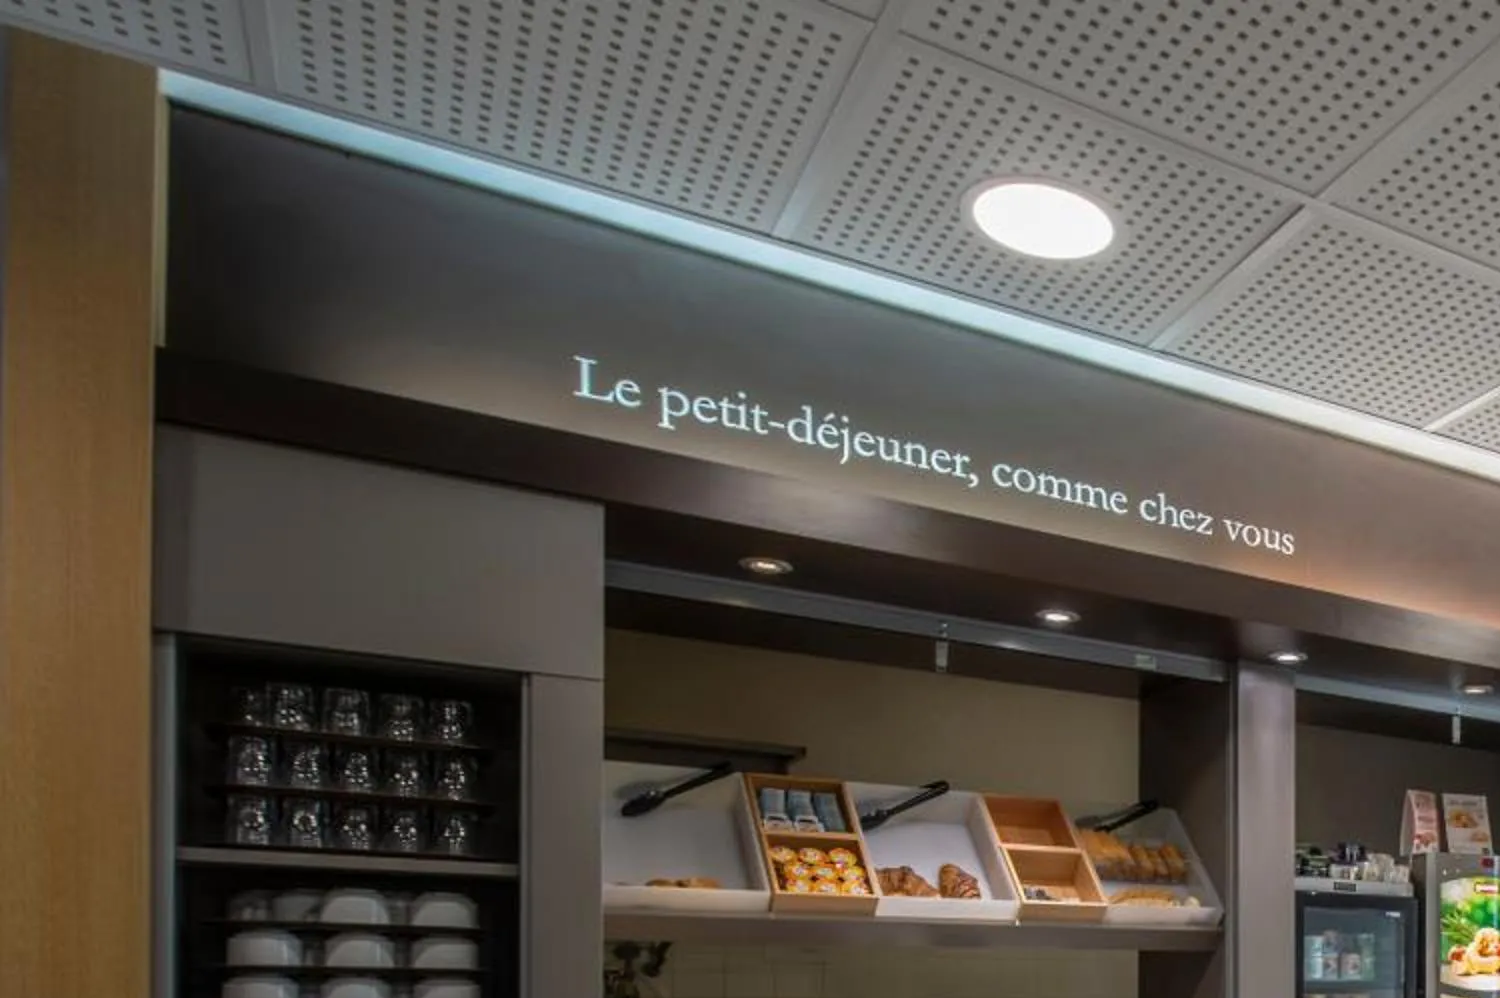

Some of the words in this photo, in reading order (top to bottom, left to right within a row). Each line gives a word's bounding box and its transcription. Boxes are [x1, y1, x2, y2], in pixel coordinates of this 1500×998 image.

[573, 355, 642, 408] Le
[657, 387, 979, 488] petit-déjeuner,
[991, 463, 1129, 515] comme
[1138, 492, 1214, 536] chez
[1222, 518, 1296, 556] vous
